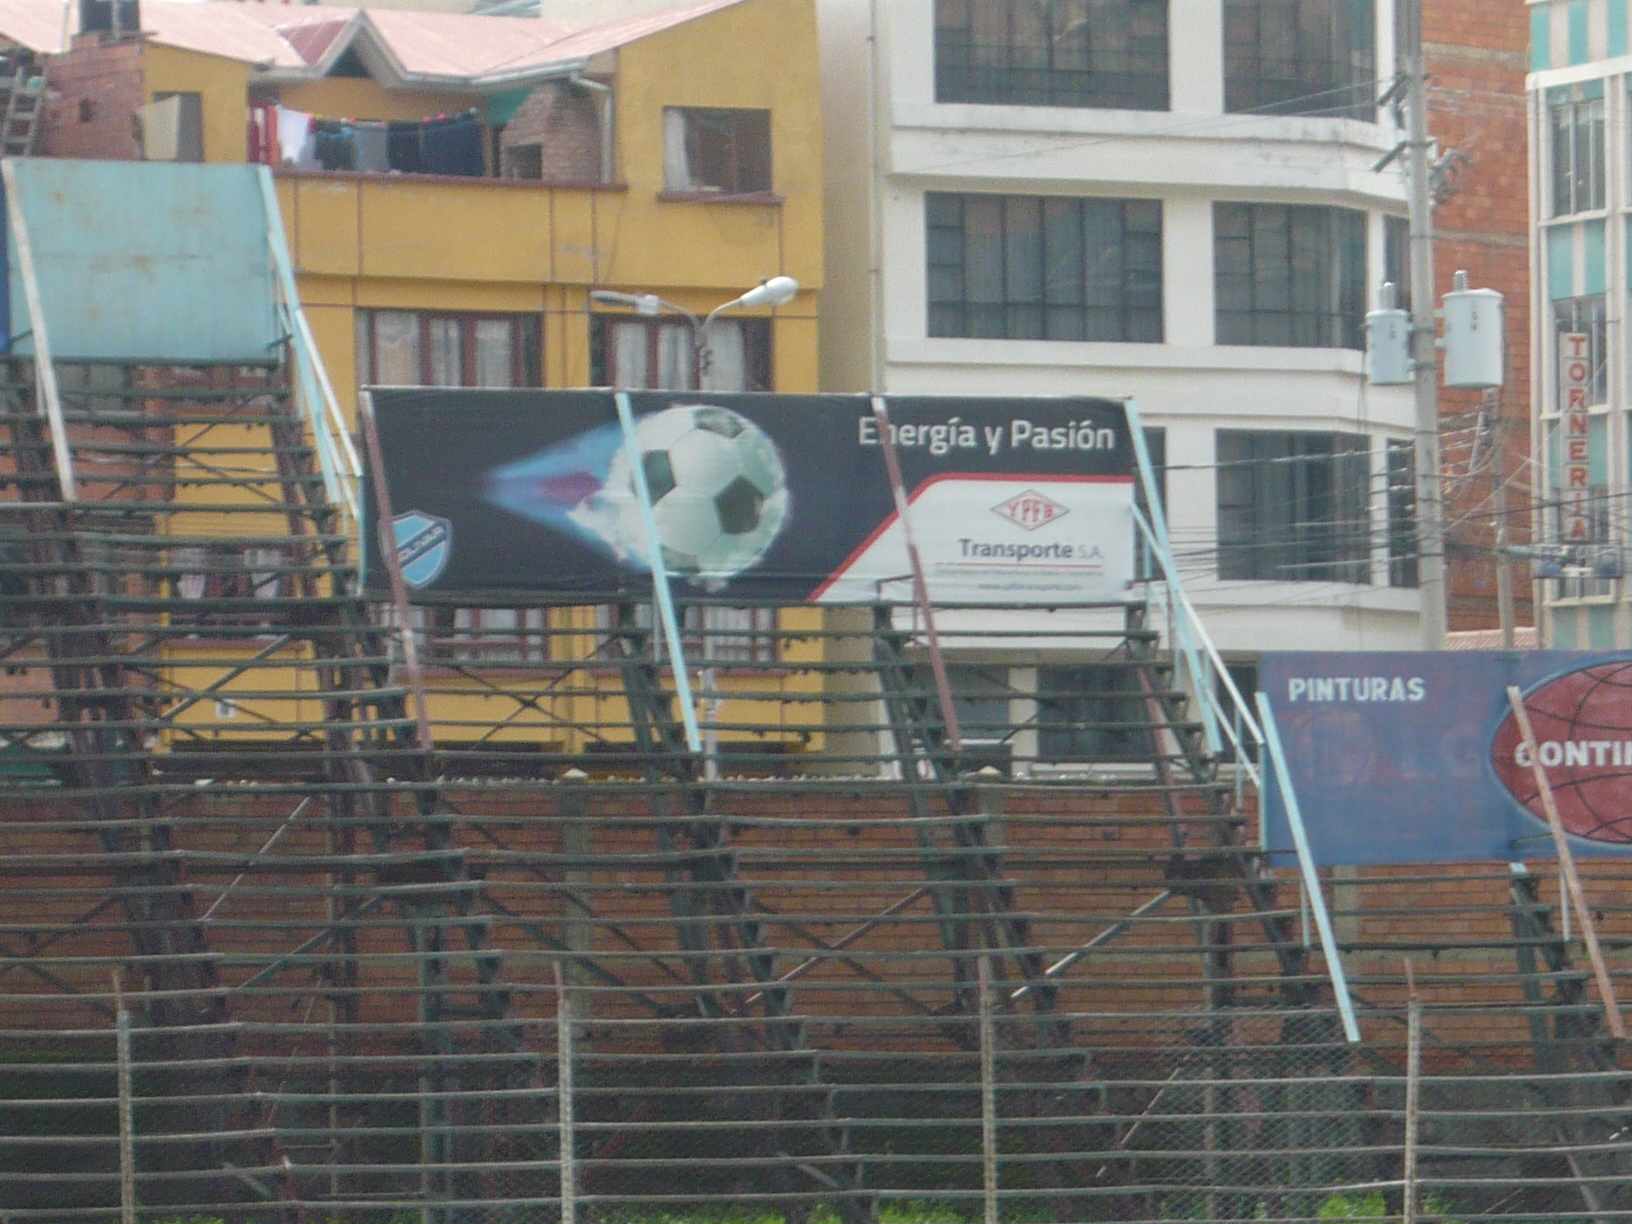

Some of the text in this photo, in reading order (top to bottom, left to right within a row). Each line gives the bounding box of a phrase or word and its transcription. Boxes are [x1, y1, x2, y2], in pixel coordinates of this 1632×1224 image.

[858, 416, 1116, 455] Energía y Pasión
[1567, 336, 1588, 539] TORNERIA
[958, 538, 1105, 562] Transporte S.A.
[1288, 676, 1426, 702] PINTURAS
